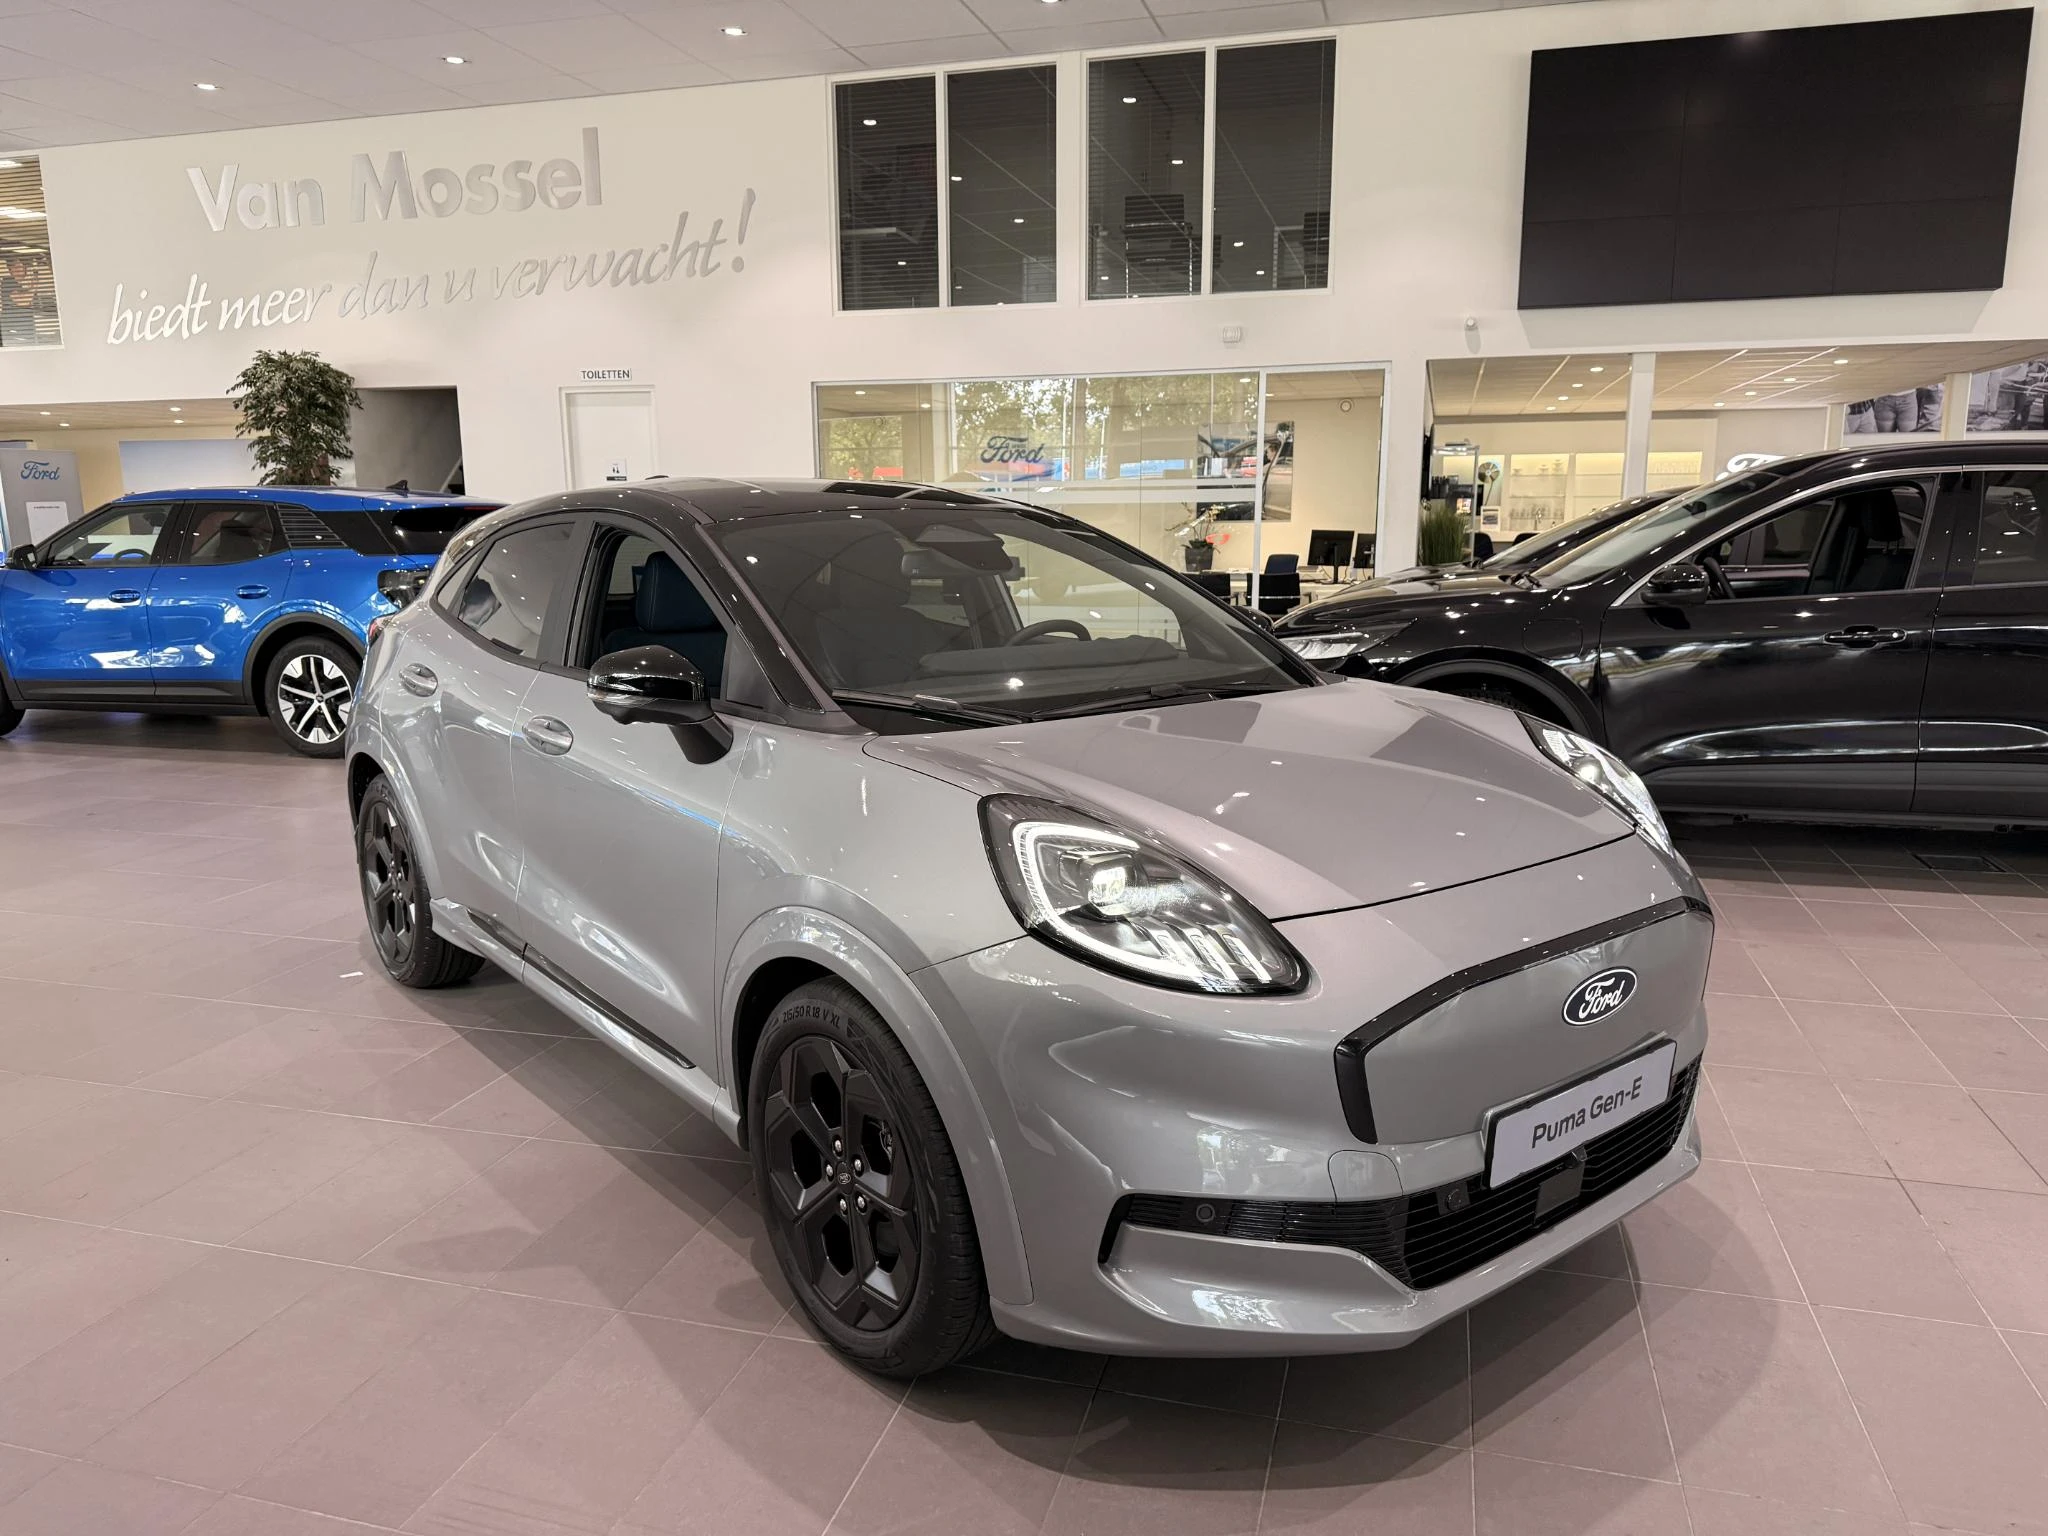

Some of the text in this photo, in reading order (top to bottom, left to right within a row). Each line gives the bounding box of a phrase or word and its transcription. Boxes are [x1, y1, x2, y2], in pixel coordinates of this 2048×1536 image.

[185, 126, 604, 232] Van Mossel
[106, 187, 757, 345] biedt meer dan u verwacht!
[581, 369, 630, 380] TOILETTEN
[981, 435, 1045, 463] Ford
[20, 460, 61, 480] Ford
[1578, 976, 1626, 1019] Ford
[782, 1005, 840, 1028] 215/50 R 18 V XL
[1531, 1075, 1643, 1149] Puma Gen-E
